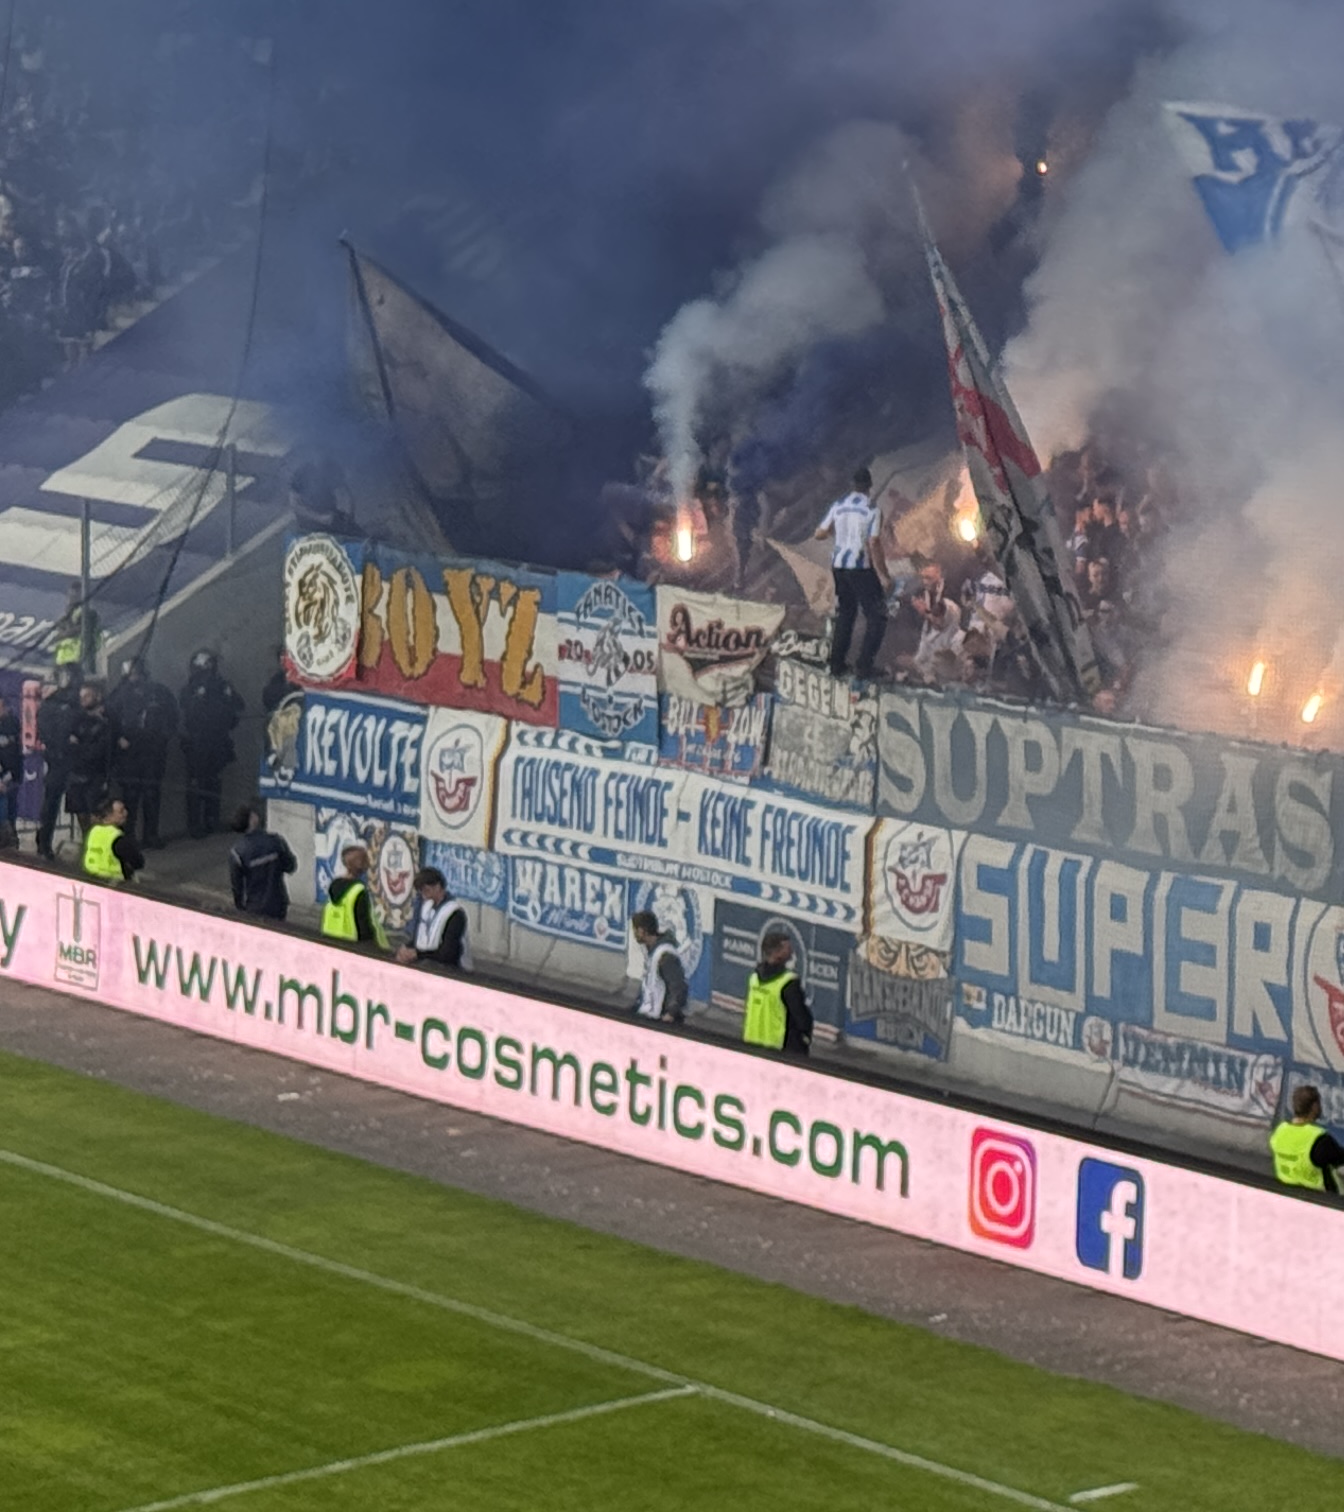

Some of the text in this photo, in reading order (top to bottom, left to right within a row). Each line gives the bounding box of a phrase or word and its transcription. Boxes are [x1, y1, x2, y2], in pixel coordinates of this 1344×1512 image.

[306, 703, 424, 793] REVOLTE
[878, 702, 1335, 891] SUPTRAS
[511, 754, 600, 833] TAUSEND
[603, 770, 674, 847] FEINDE
[698, 788, 756, 866] KEINE
[760, 803, 857, 894] FREUNDE
[514, 857, 624, 922] WAREN
[955, 830, 1297, 1044] SUPER
[59, 940, 97, 969] MBR
[133, 933, 911, 1198] www.mbr-cosmetics.com
[991, 993, 1077, 1047] DARGUN
